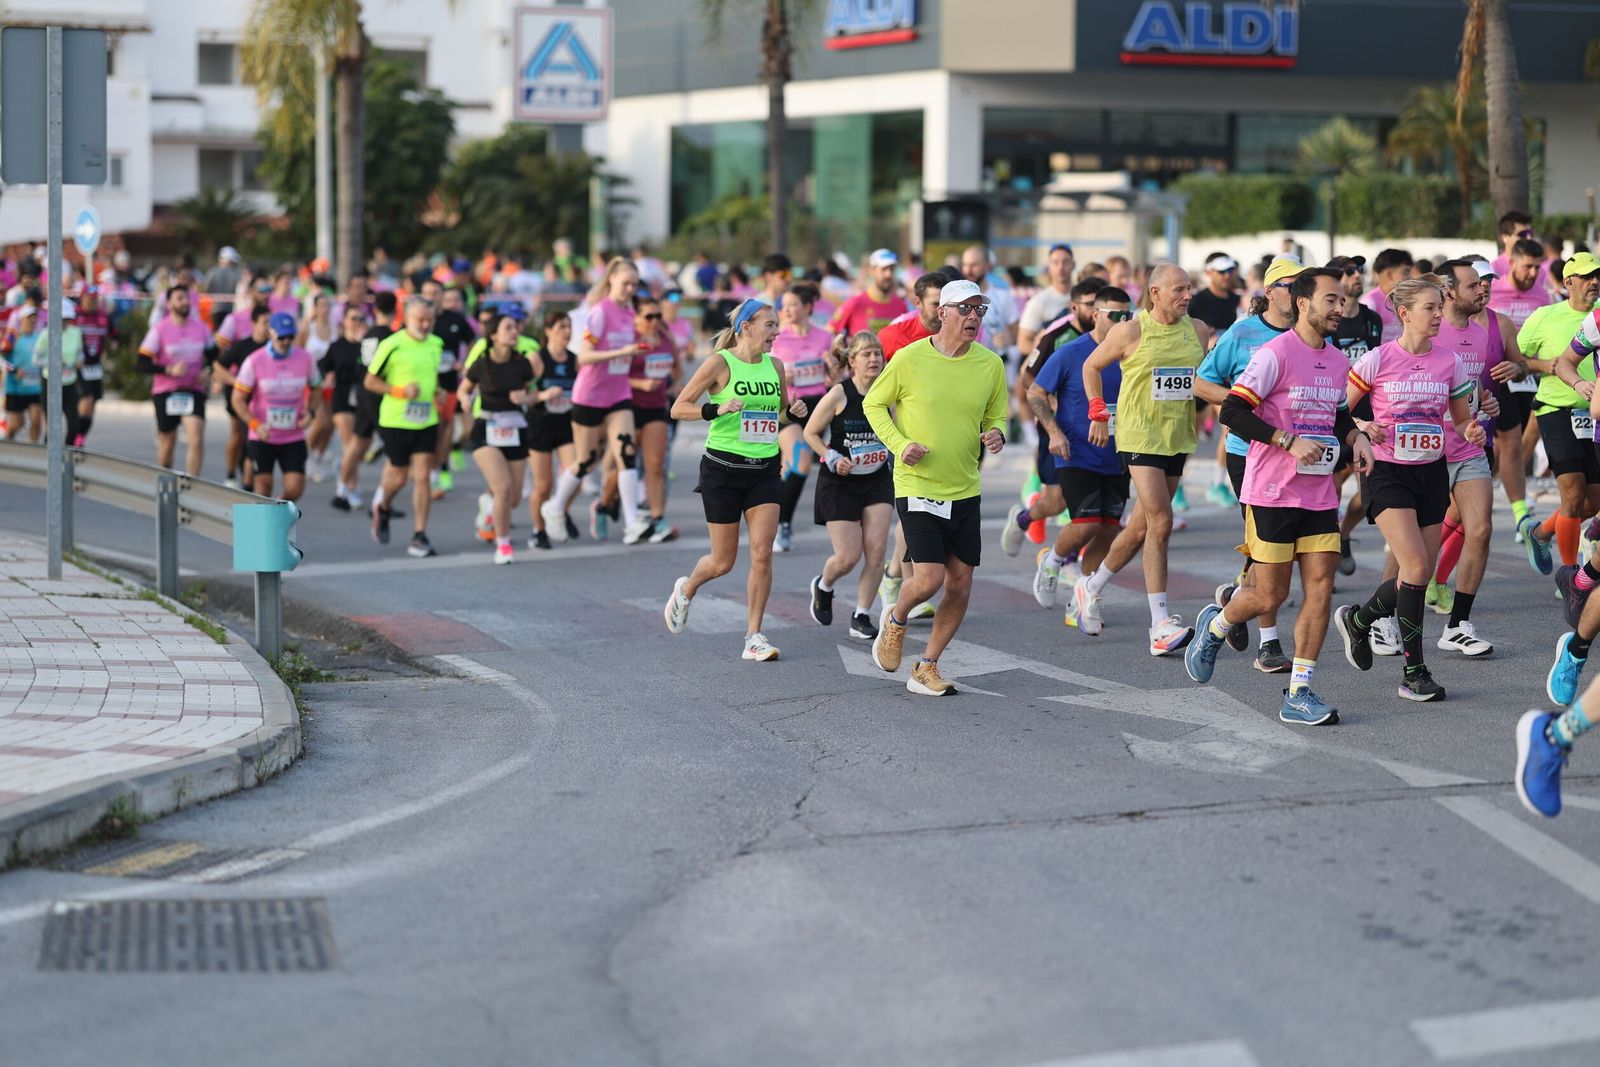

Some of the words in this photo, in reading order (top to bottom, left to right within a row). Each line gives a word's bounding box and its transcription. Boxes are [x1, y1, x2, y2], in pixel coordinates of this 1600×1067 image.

[1122, 1, 1299, 55] ALDI
[1155, 376, 1192, 390] 1498
[1314, 376, 1333, 387] XXXVI
[1383, 381, 1412, 393] MEDIA
[1288, 386, 1319, 400] MEDIA
[743, 420, 777, 433] 1176
[1399, 433, 1441, 450] 1183
[855, 451, 886, 466] 1286
